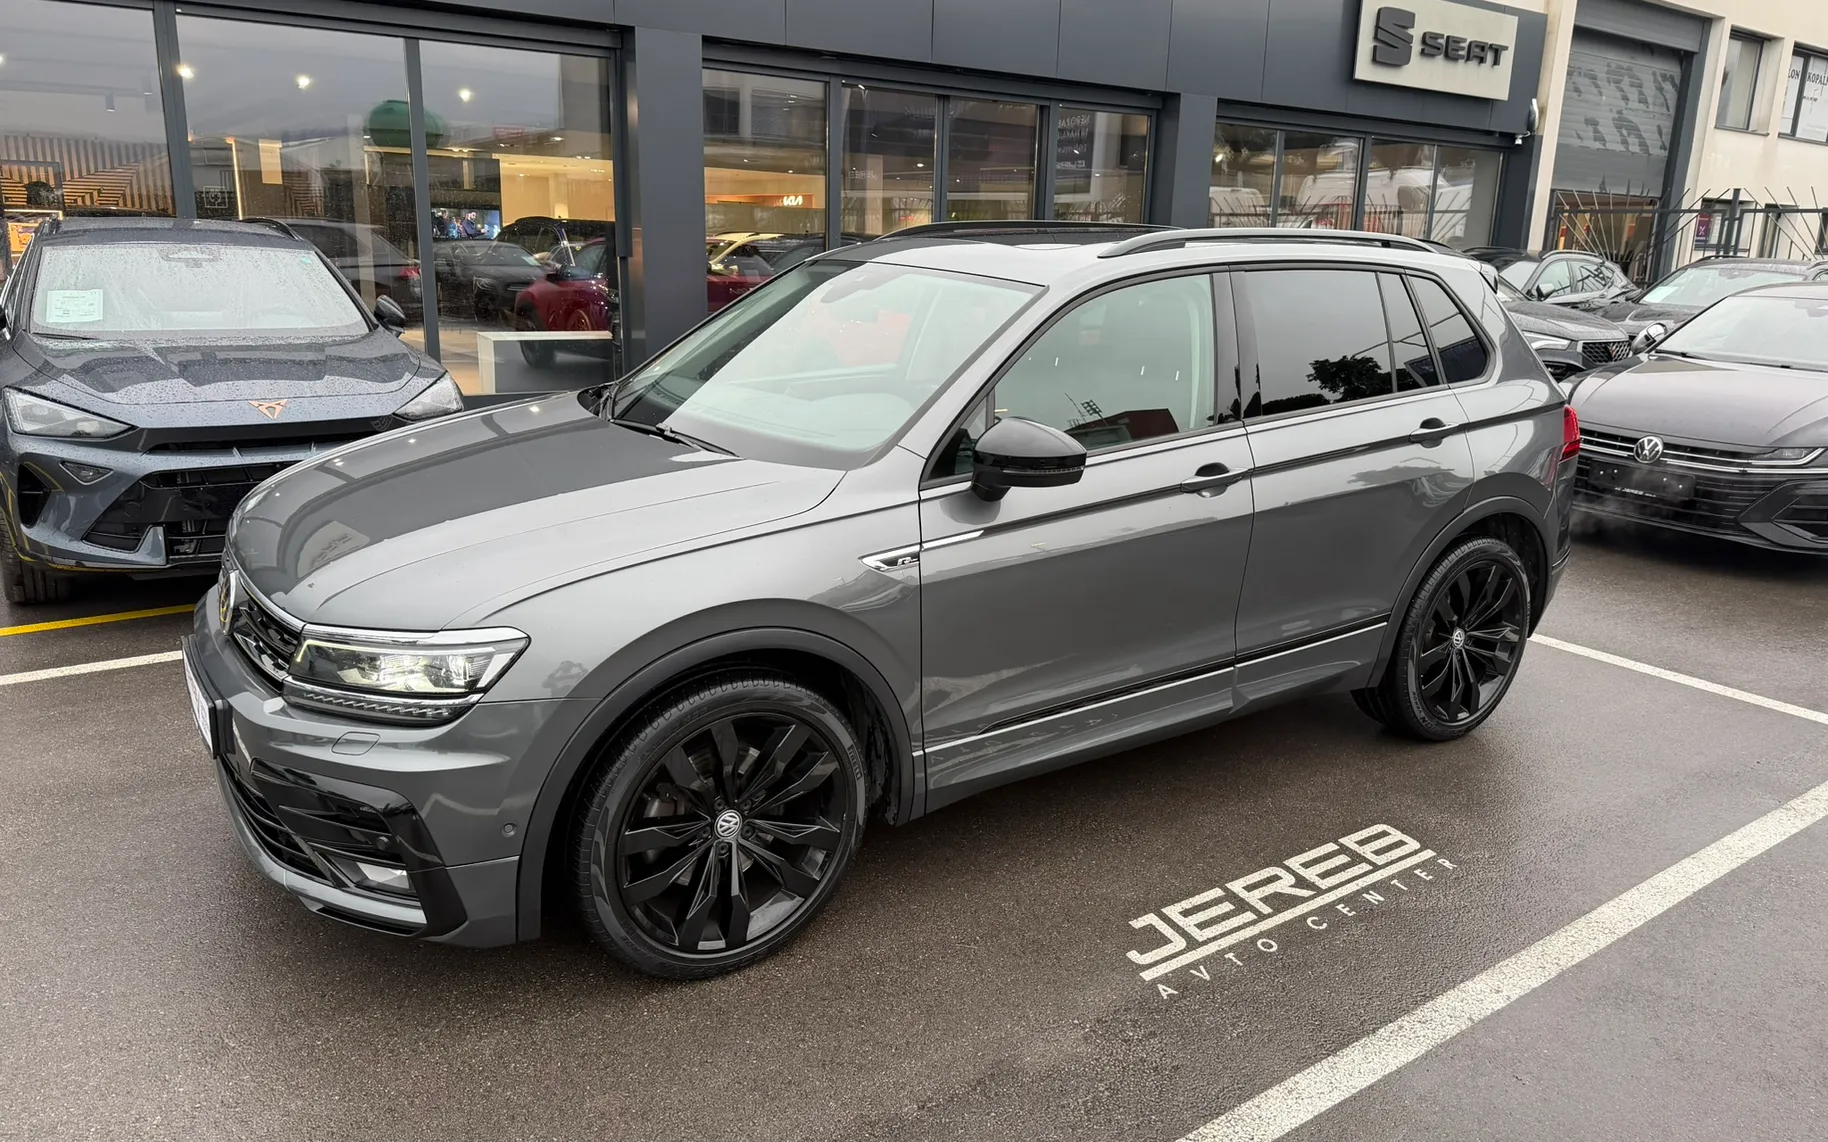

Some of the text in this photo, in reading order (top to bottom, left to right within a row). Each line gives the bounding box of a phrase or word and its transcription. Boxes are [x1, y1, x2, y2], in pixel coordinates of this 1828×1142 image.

[1420, 31, 1509, 67] SEAT
[1806, 71, 1828, 86] KOPAL
[1125, 823, 1421, 965] JEREB
[1156, 857, 1458, 999] AVTO CENTER
